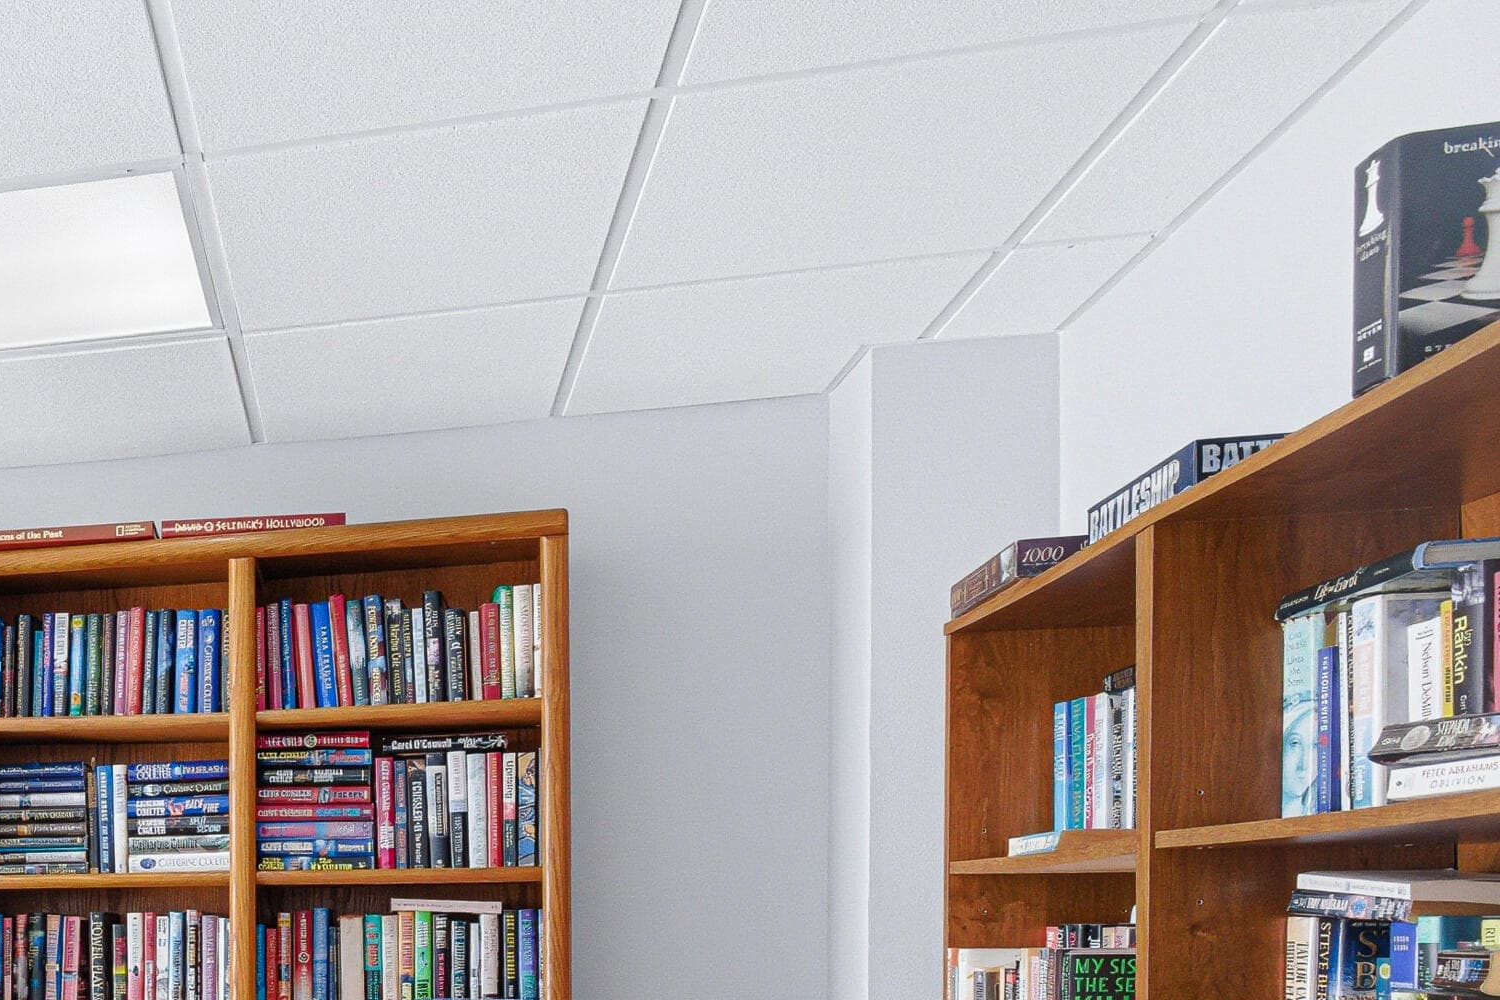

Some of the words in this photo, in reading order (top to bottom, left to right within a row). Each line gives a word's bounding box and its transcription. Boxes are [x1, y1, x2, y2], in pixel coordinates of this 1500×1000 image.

[1090, 459, 1180, 544] BATTLESHIP
[265, 517, 325, 529] HOLLYWOOD
[15, 531, 25, 541] of
[27, 530, 42, 540] the
[43, 530, 63, 539] Past
[1022, 545, 1064, 563] 1000
[1421, 642, 1432, 677] Nelson
[1454, 616, 1468, 685] Rankin
[1448, 762, 1500, 777] ABRAHAMS
[1430, 776, 1485, 790] OBLIVION
[92, 921, 104, 958] POWER
[1319, 922, 1332, 970] STEVE
[1075, 958, 1106, 975] MY
[92, 965, 104, 989] PLAY
[1075, 977, 1108, 992] THE
[1115, 977, 1136, 992] SE
